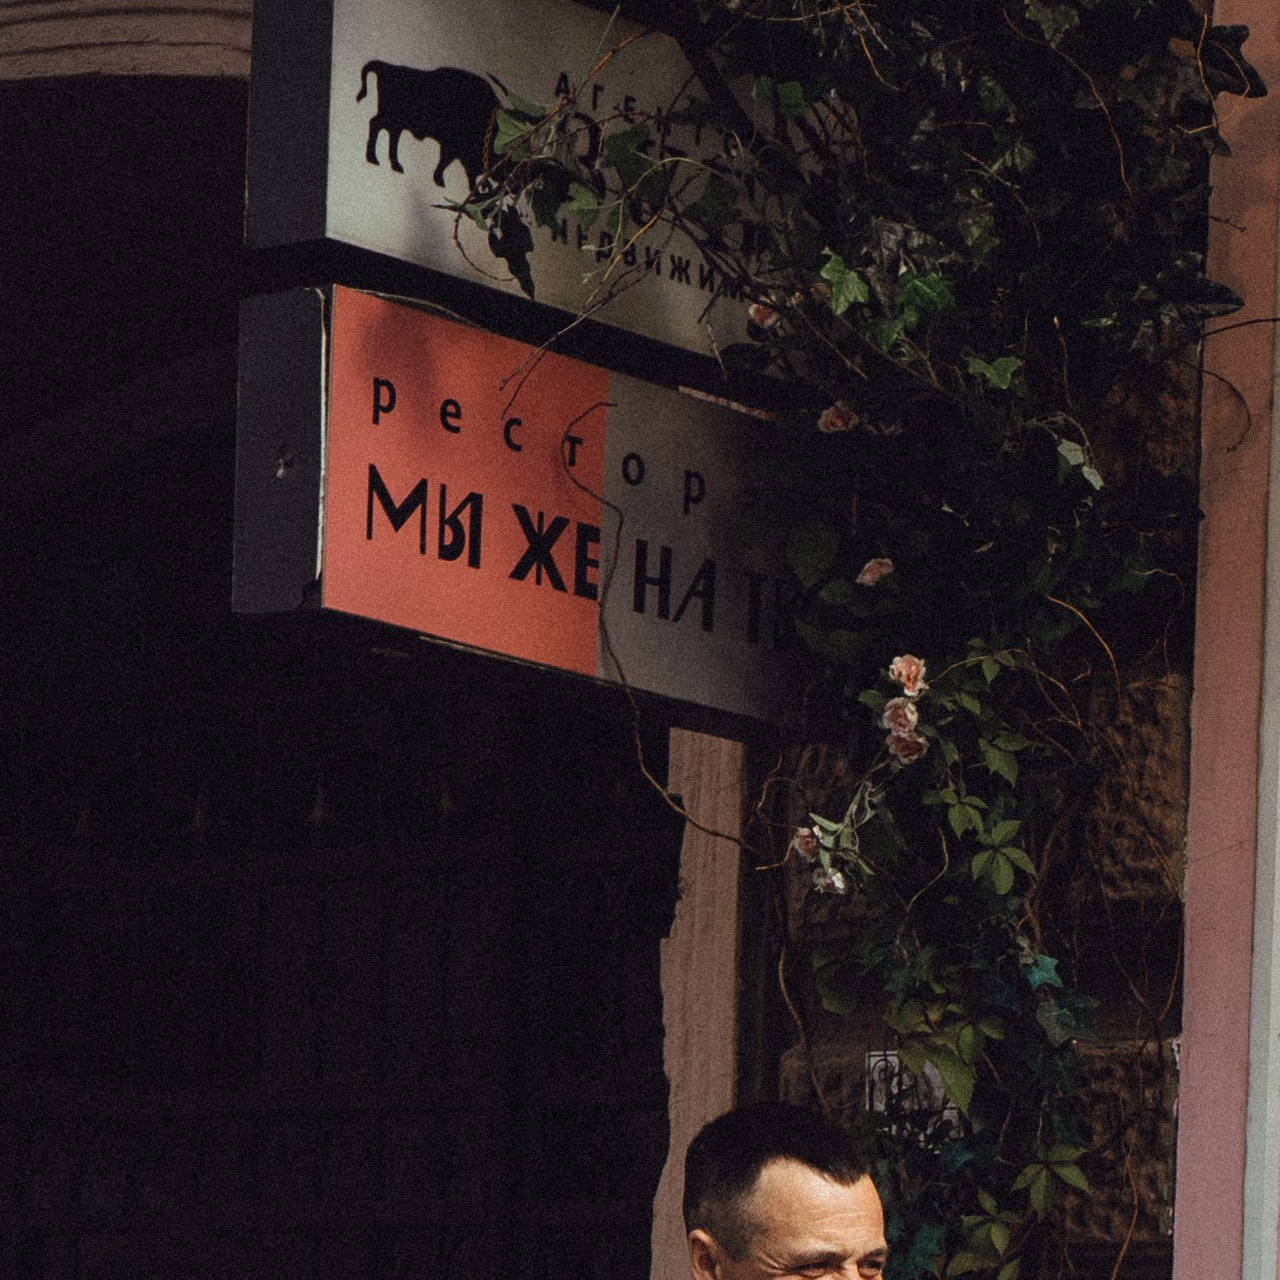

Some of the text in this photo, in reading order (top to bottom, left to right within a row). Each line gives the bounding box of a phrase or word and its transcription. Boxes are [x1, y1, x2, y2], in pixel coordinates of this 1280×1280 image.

[371, 376, 707, 515] рестор
[366, 463, 483, 570] МЫ
[510, 504, 601, 600] ЖЕ
[633, 539, 717, 632] НА
